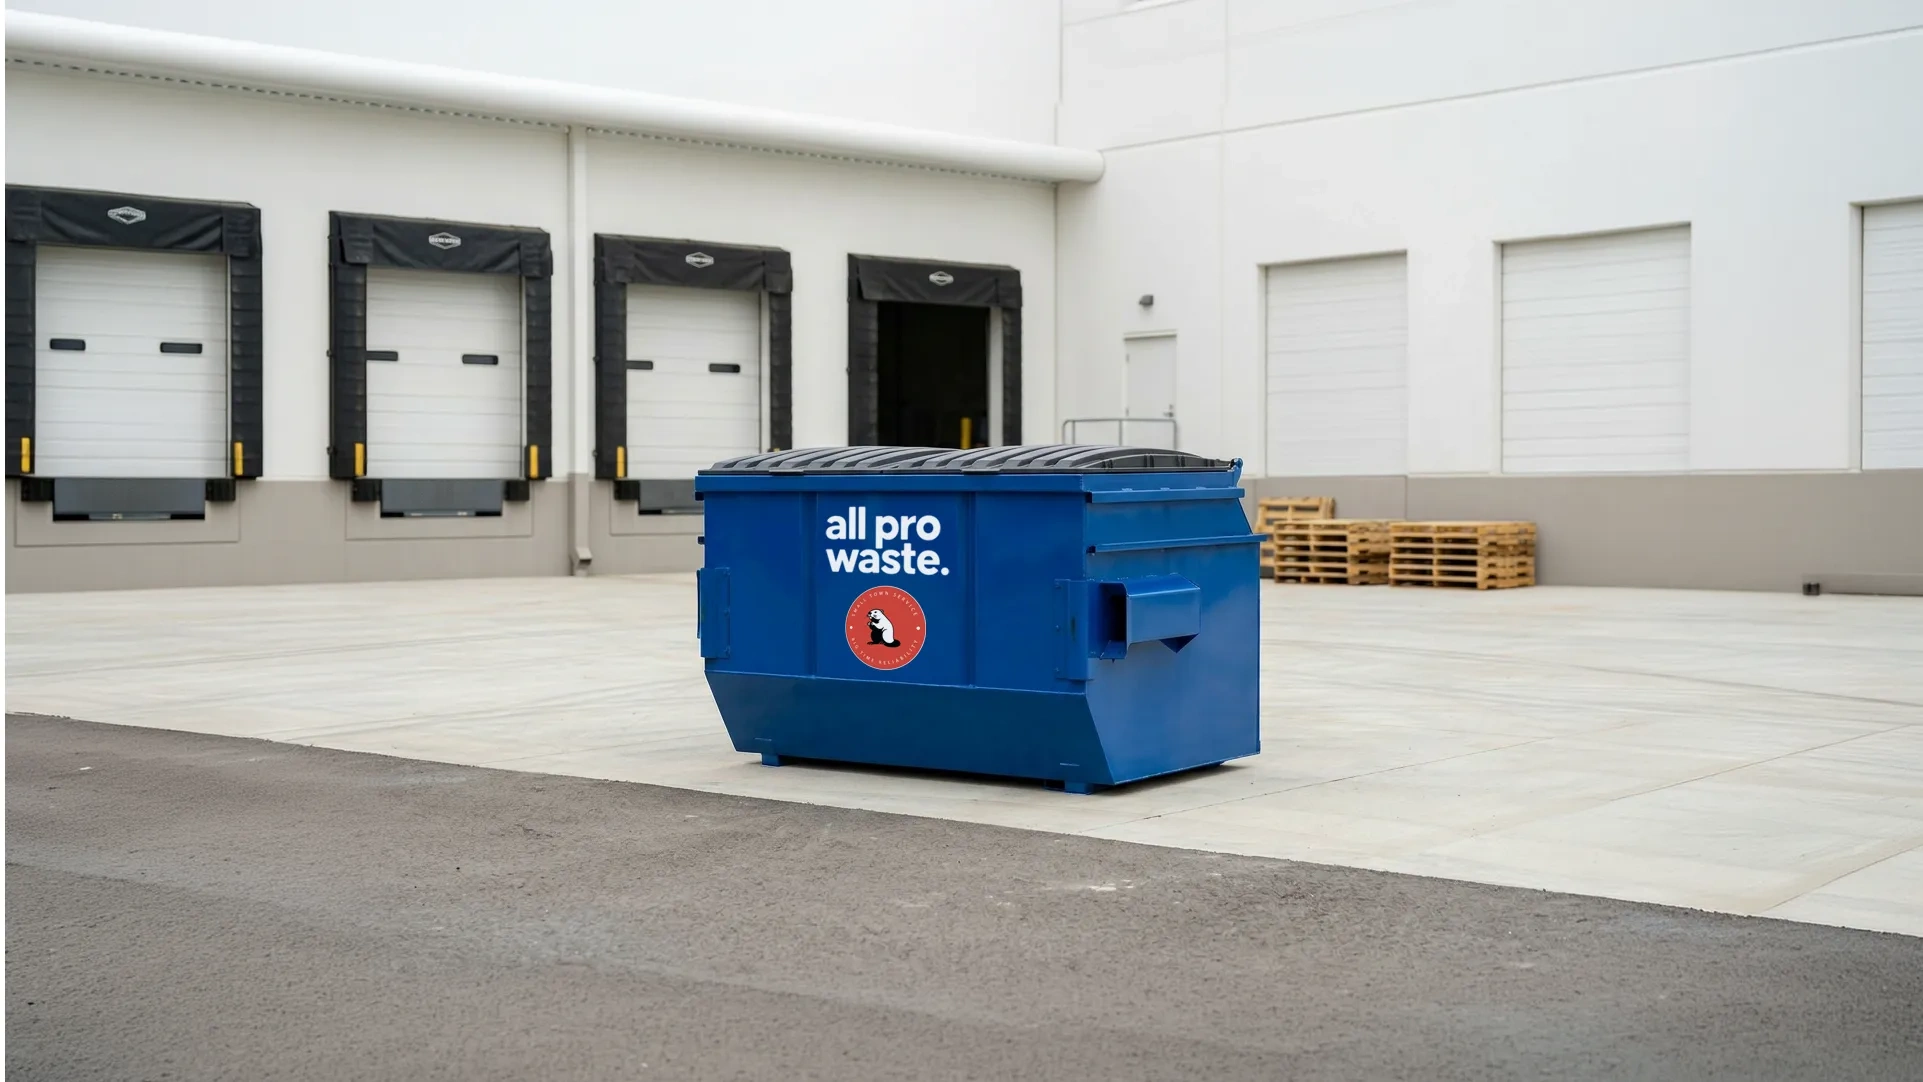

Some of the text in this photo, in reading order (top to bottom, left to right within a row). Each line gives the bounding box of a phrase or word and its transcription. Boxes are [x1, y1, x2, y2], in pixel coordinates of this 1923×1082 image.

[825, 506, 941, 549] all pro
[825, 543, 950, 576] waste.
[852, 598, 867, 617] SMALL
[893, 592, 918, 616] SERVICE
[851, 637, 918, 666] BIG TIME RELIABILITY
